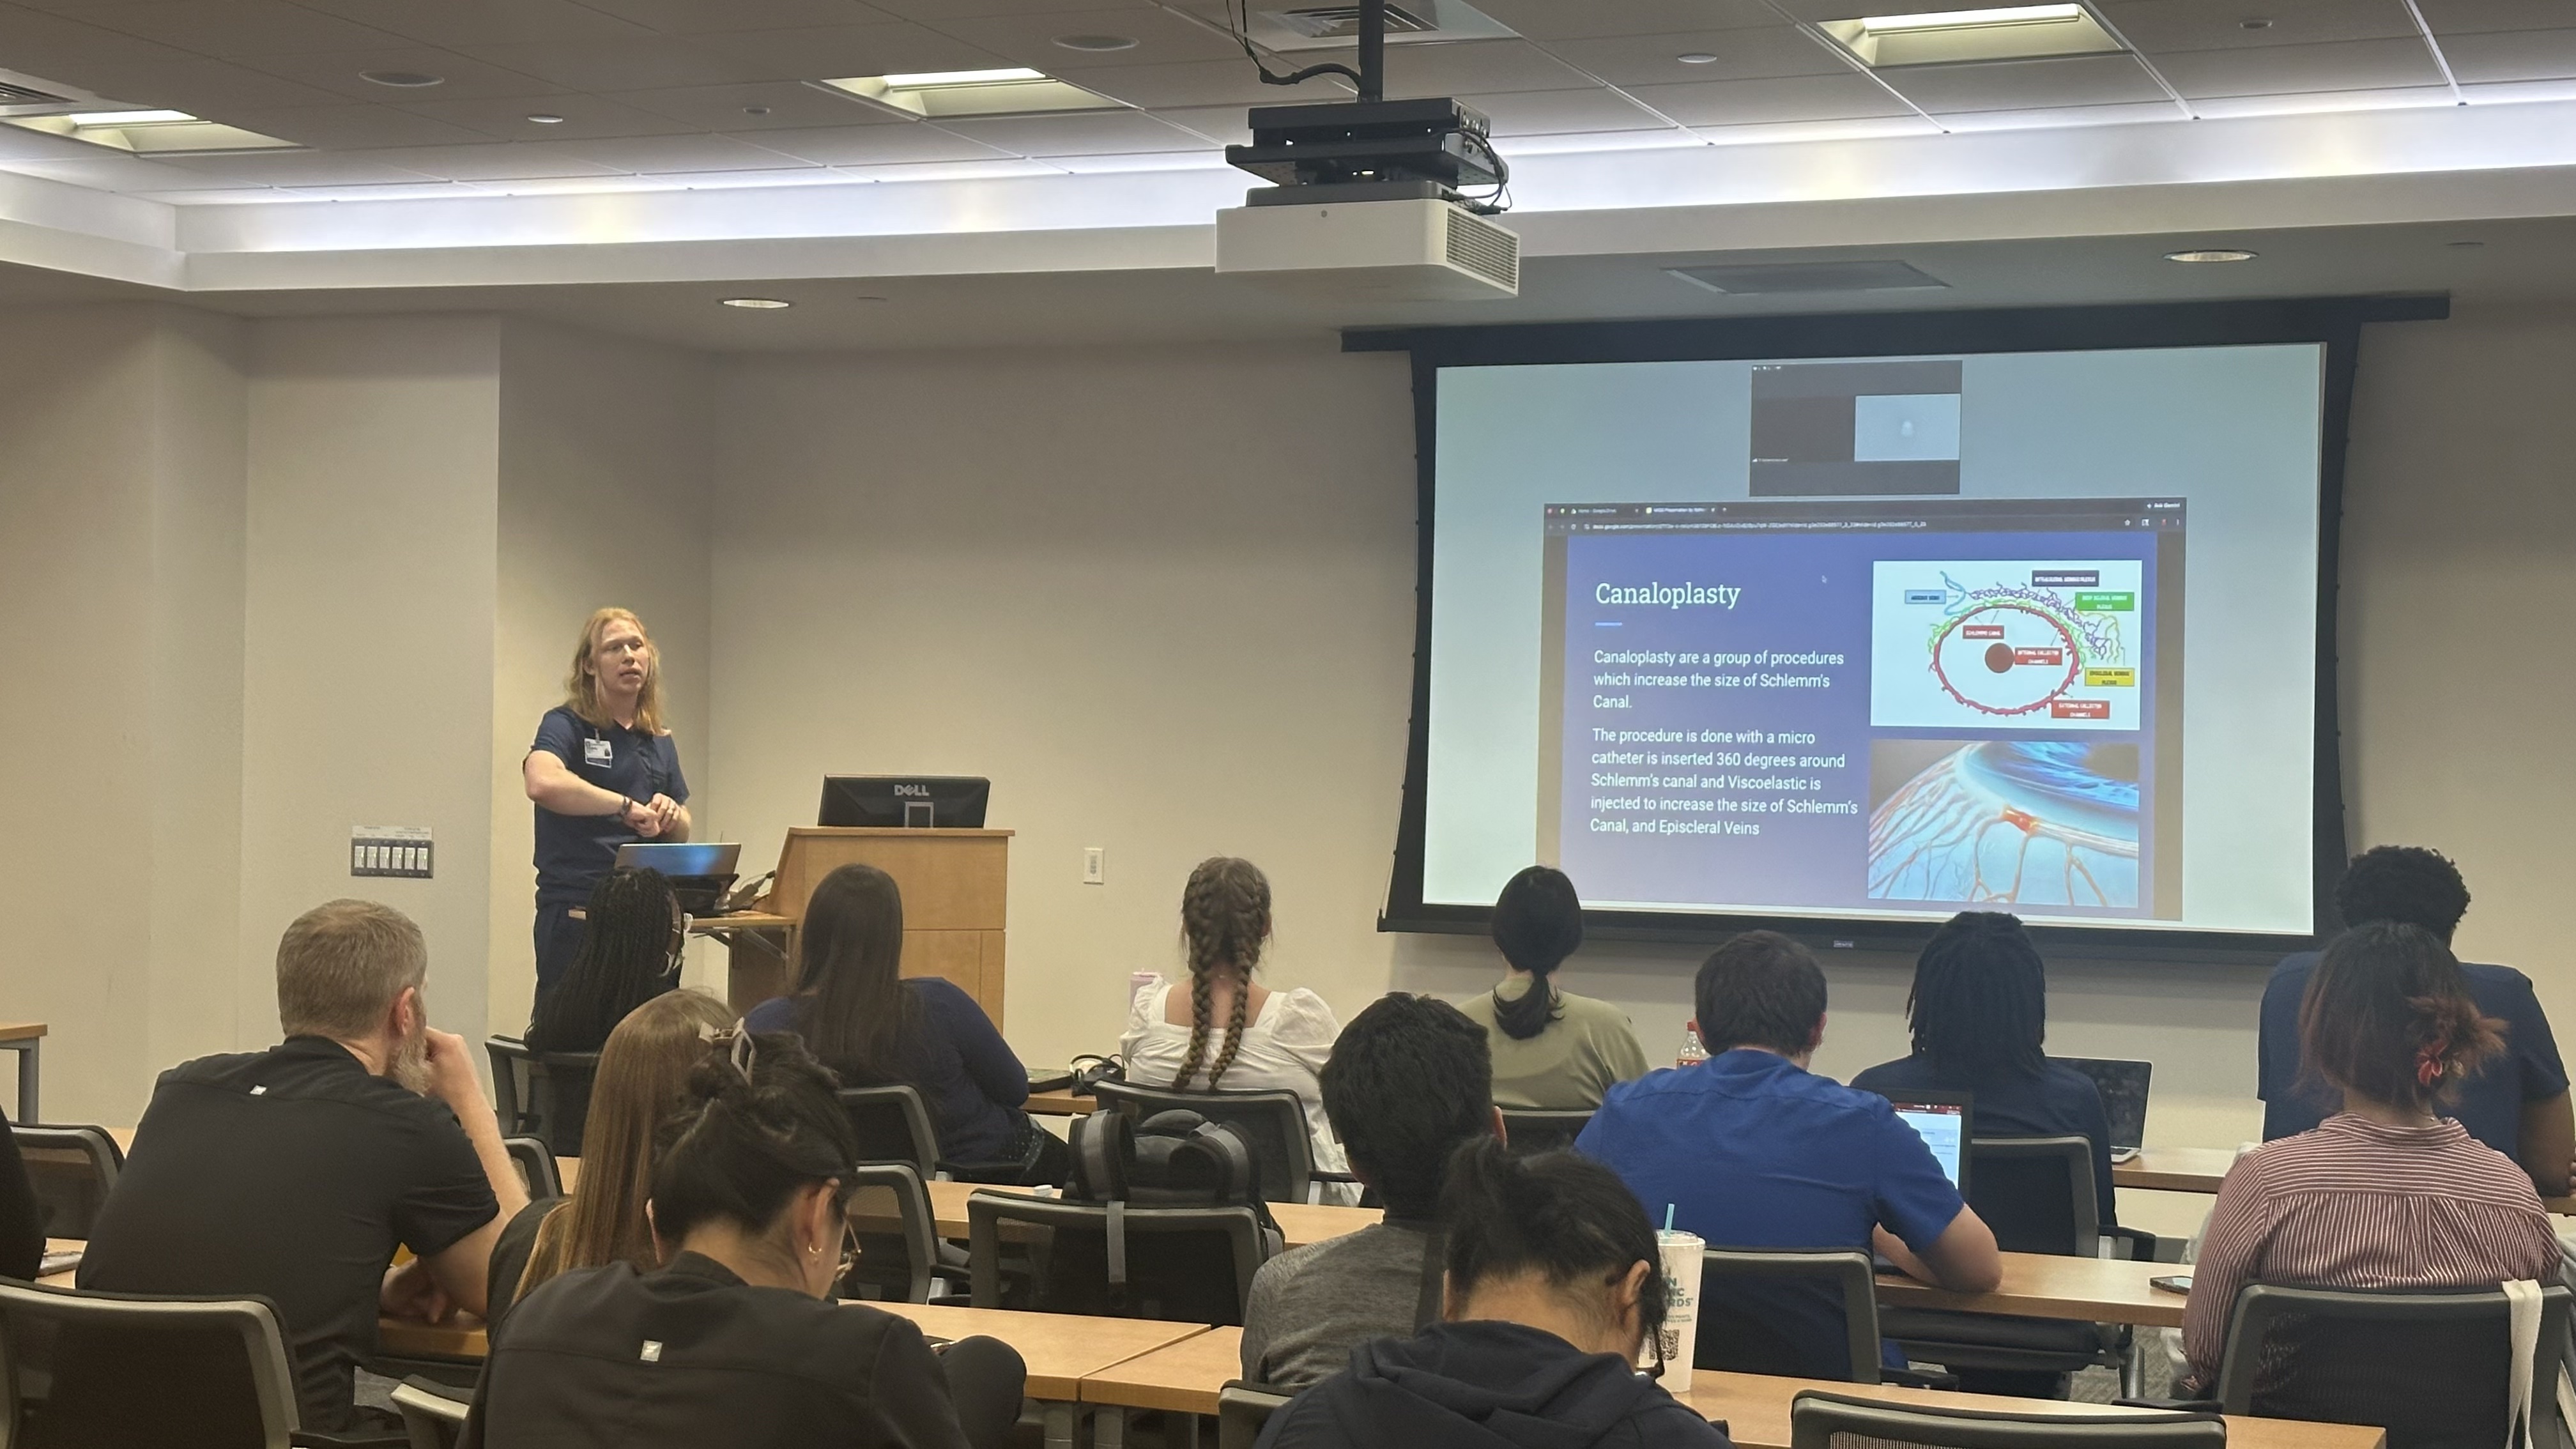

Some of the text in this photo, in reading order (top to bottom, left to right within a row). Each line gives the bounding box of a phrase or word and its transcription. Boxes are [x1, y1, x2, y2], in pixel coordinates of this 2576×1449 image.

[1595, 582, 1741, 609] Canaloplasty
[1594, 650, 1844, 667] Canaloplasty are a group of procedures
[1594, 673, 1830, 687] which increase the size of Schlemm's
[1593, 695, 1632, 708] Canal.
[1593, 728, 1815, 744] The procedure is done with a micro
[1592, 751, 1845, 769] catheter is inserted 360 degrees around
[1591, 773, 1821, 790] Schlemm's canal and Viscoelastic is
[894, 785, 929, 796] DELL
[1591, 796, 1858, 814] injected to increase the size of Schlemm's
[1590, 818, 1759, 835] Canal, and Episcleral Veins
